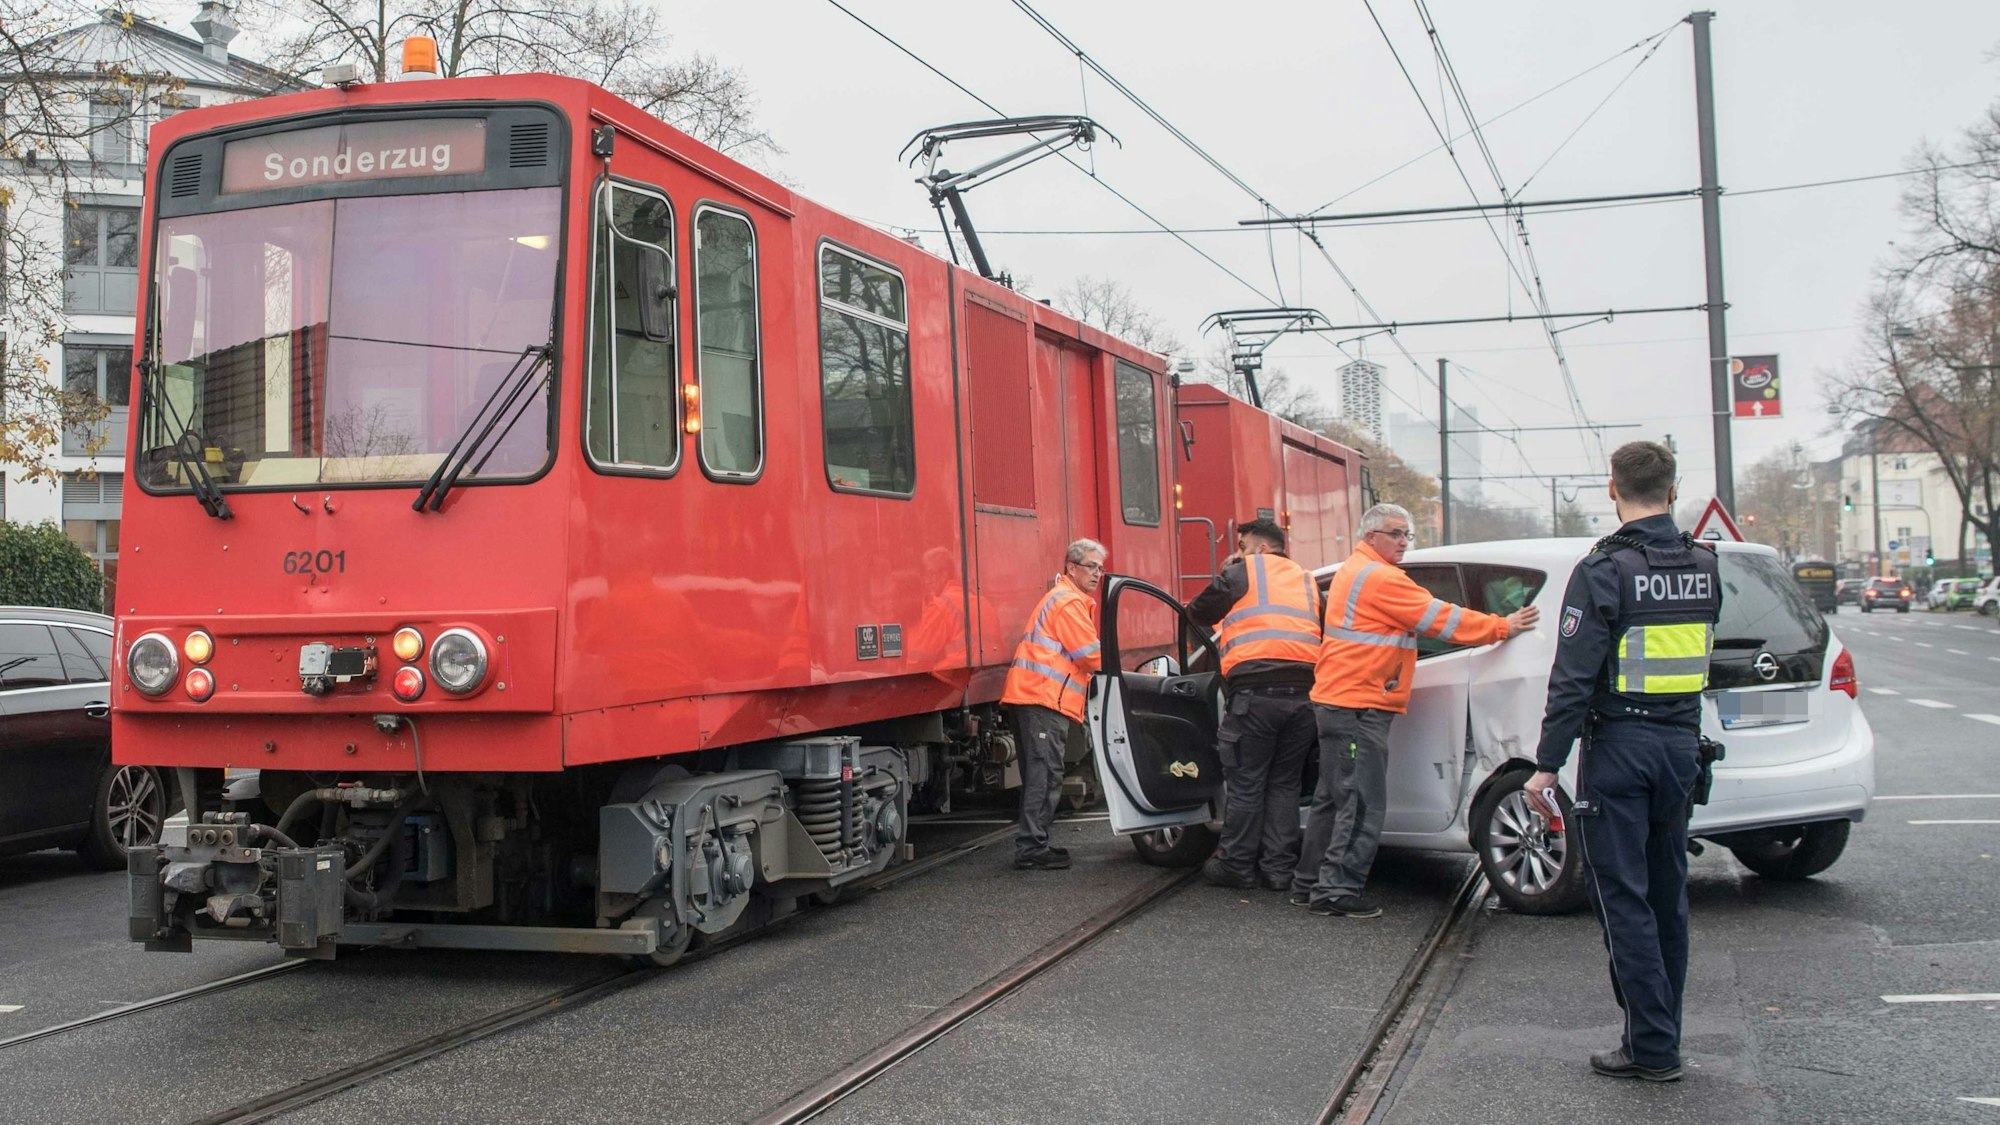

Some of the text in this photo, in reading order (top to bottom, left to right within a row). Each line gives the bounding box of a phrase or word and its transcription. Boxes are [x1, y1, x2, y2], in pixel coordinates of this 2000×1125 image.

[263, 143, 450, 181] Sonderzug
[283, 550, 346, 575] 6201
[1634, 573, 1712, 601] POLIZEI
